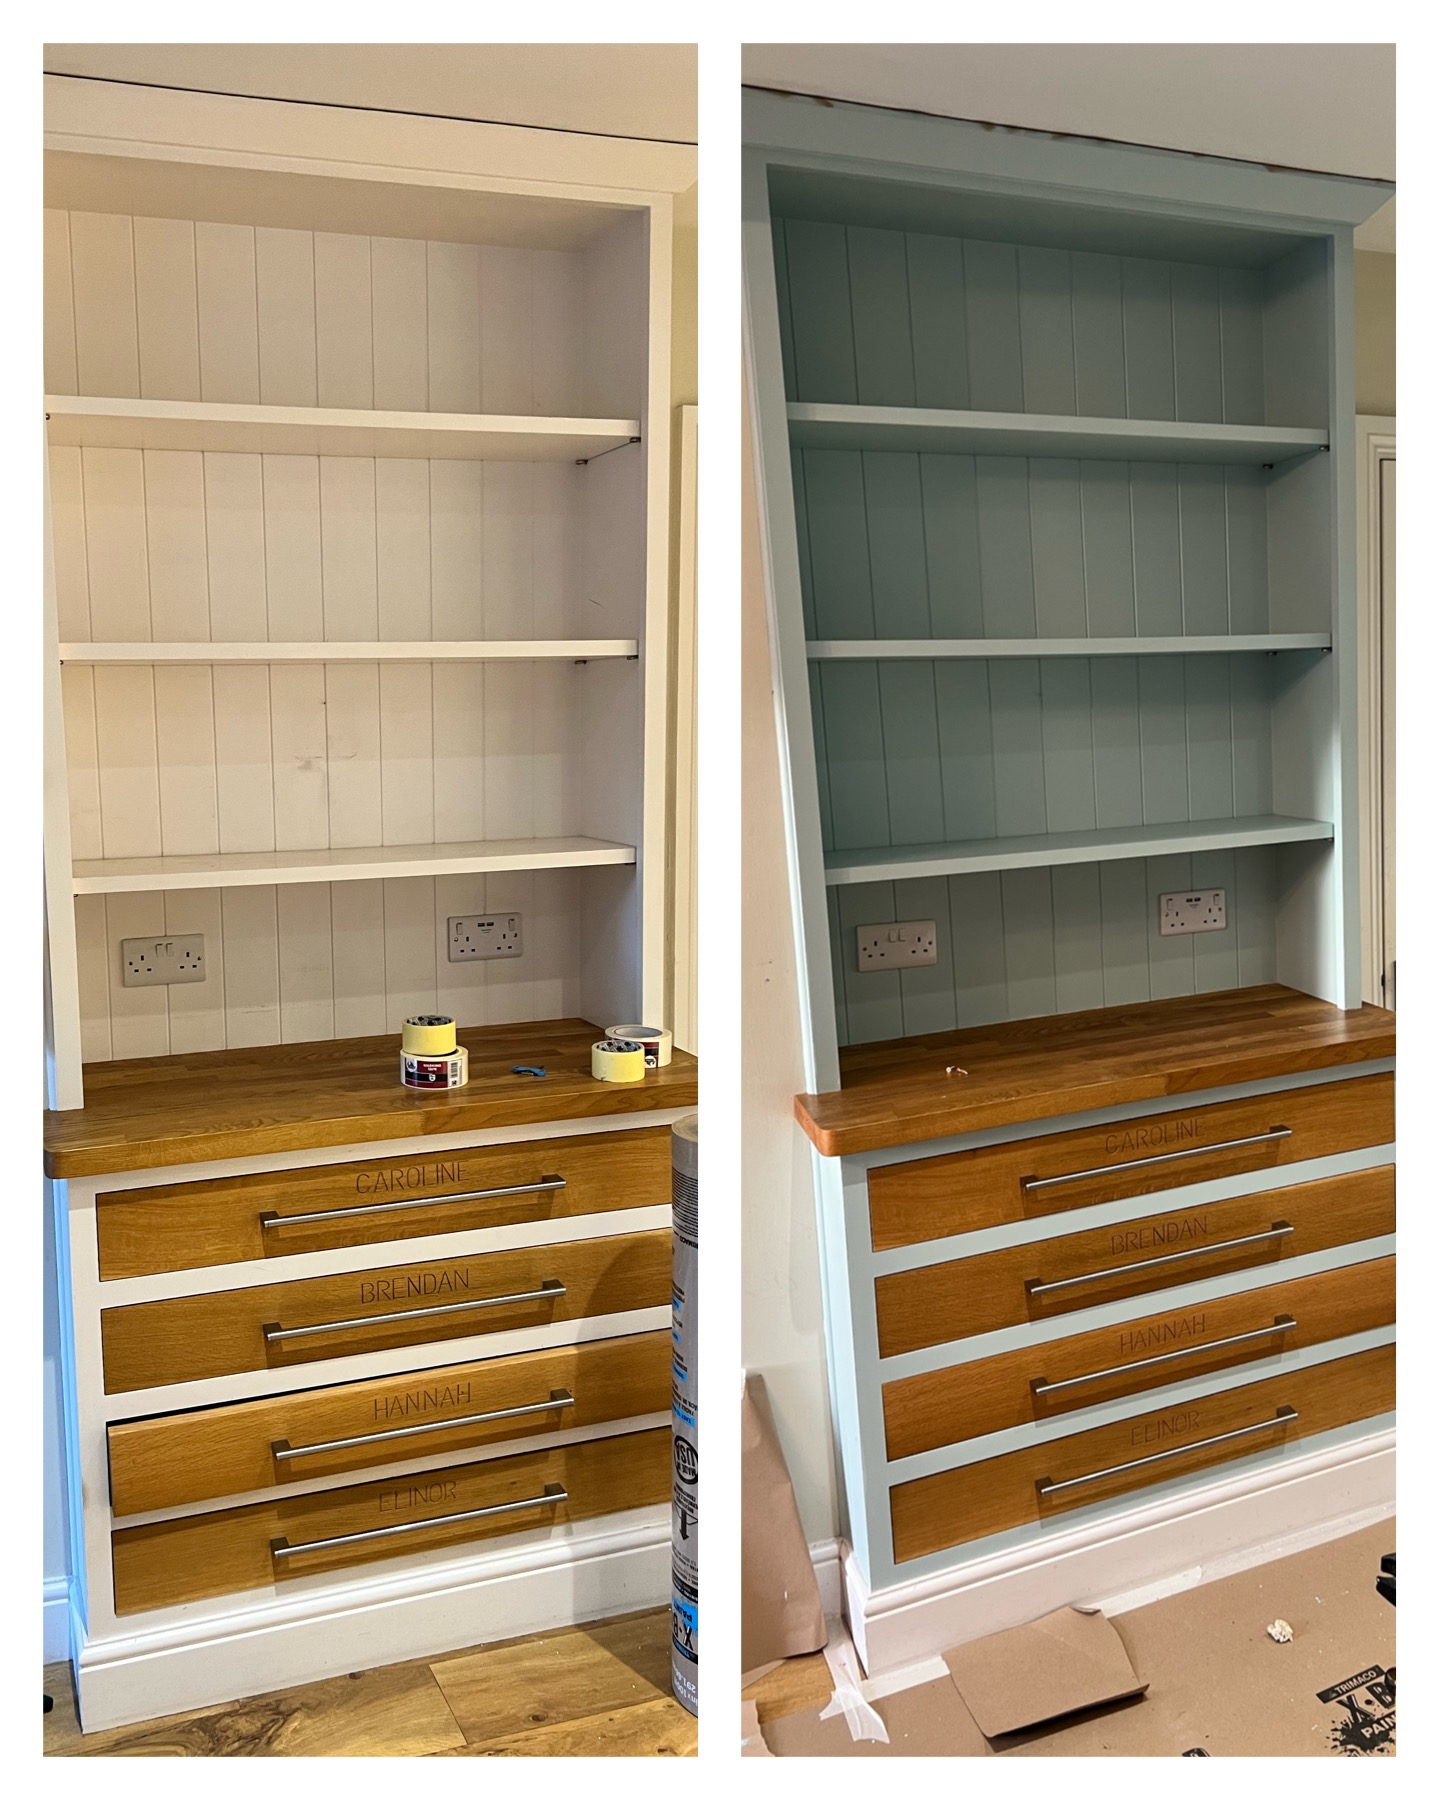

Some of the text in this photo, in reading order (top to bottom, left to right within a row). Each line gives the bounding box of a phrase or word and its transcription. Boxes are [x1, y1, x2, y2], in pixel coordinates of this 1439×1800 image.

[1105, 1117, 1205, 1155] CAROLINE
[355, 1161, 470, 1194] CAROLINE
[679, 1235, 698, 1249] RIMACO
[1111, 1215, 1208, 1256] BRENDAN
[361, 1268, 470, 1304] BRENDAN
[1120, 1313, 1206, 1354] HANNAH
[374, 1382, 471, 1421] HANNAH
[1131, 1410, 1200, 1446] ELINOR
[676, 1442, 695, 1467] USA
[379, 1479, 457, 1513] ELINOR
[1334, 1670, 1377, 1695] TRIMACO
[1360, 1713, 1396, 1739] PAIN
